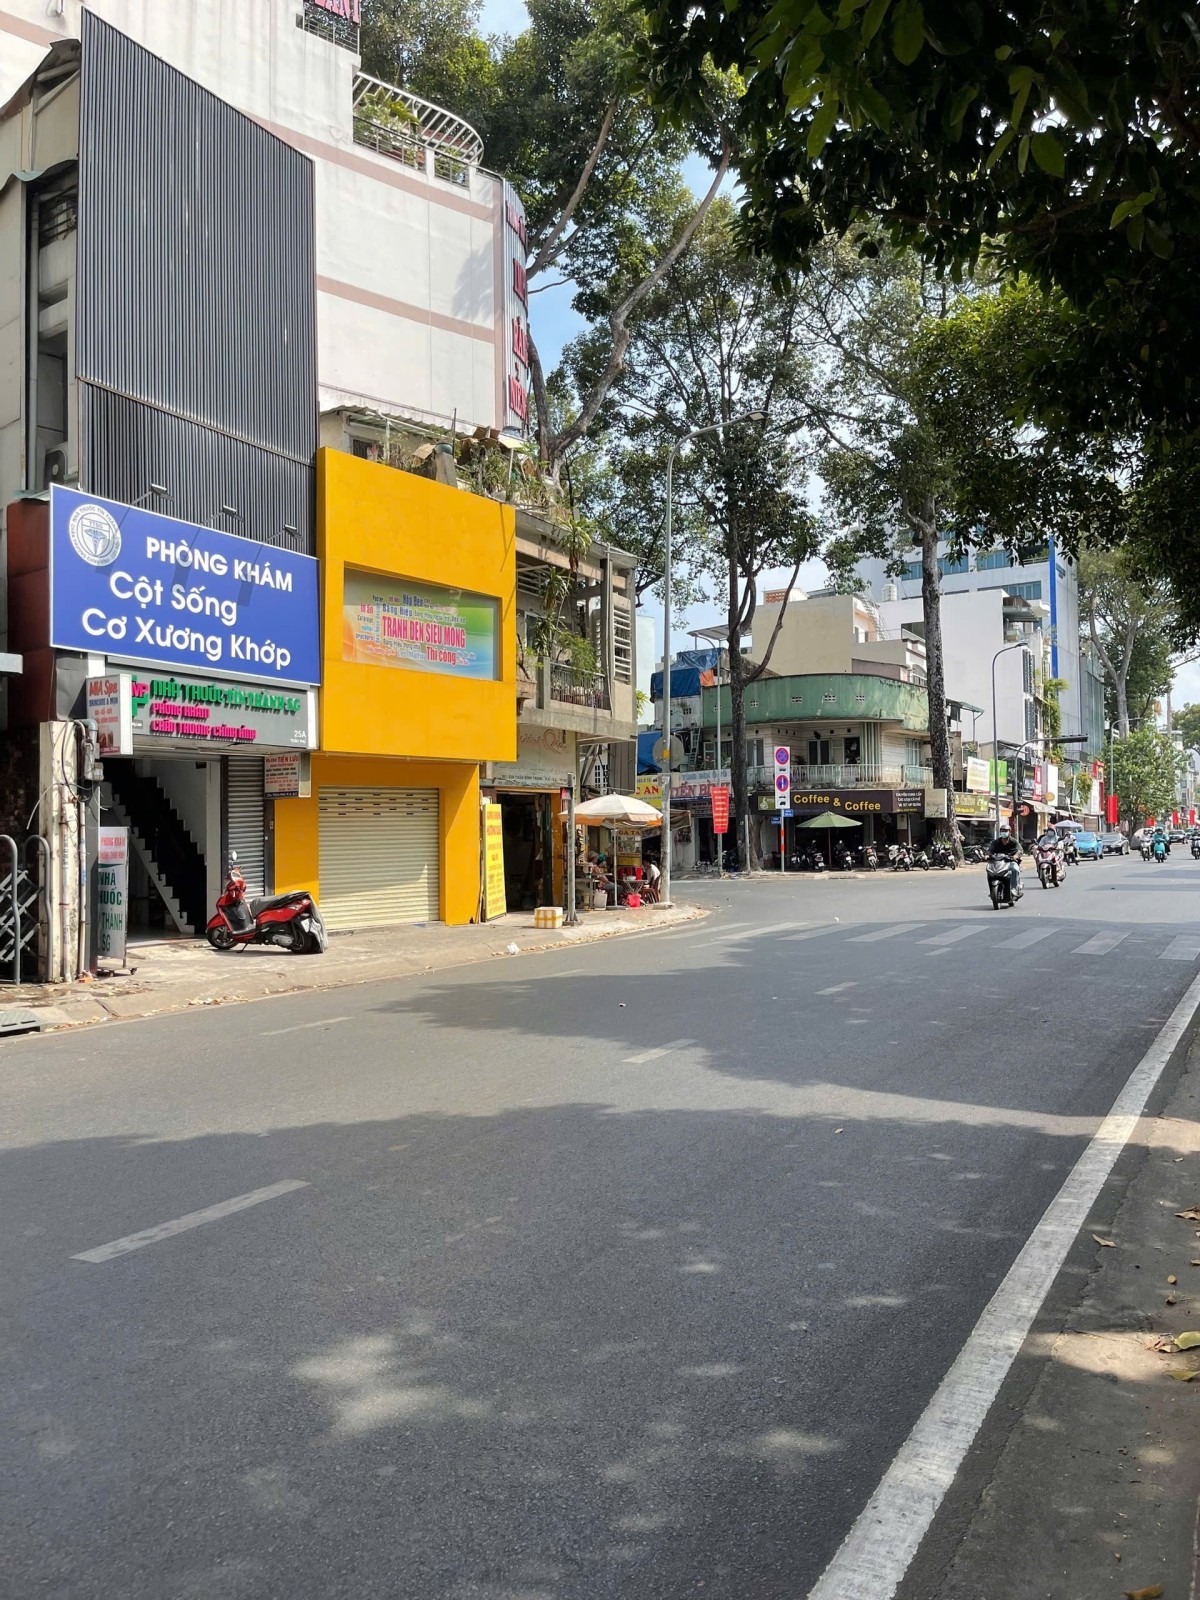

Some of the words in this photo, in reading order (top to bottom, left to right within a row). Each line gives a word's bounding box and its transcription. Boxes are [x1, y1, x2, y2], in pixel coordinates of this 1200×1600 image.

[146, 536, 228, 576] PHÒNG
[234, 558, 293, 593] KHÁM
[109, 571, 164, 609] Cột
[171, 584, 237, 627] Sống
[82, 608, 128, 640] Cơ
[135, 616, 222, 662] Xương
[231, 634, 291, 671] Khớp
[381, 615, 408, 640] TRANH
[425, 620, 442, 645] SIÊU
[152, 678, 181, 699] NHÀ
[184, 682, 224, 703] THUỐC
[286, 697, 301, 712] SG
[294, 729, 307, 738] 25A
[793, 795, 830, 804] Coffee
[833, 798, 841, 807] &
[844, 801, 881, 810] Coffee
[102, 933, 111, 952] SG
